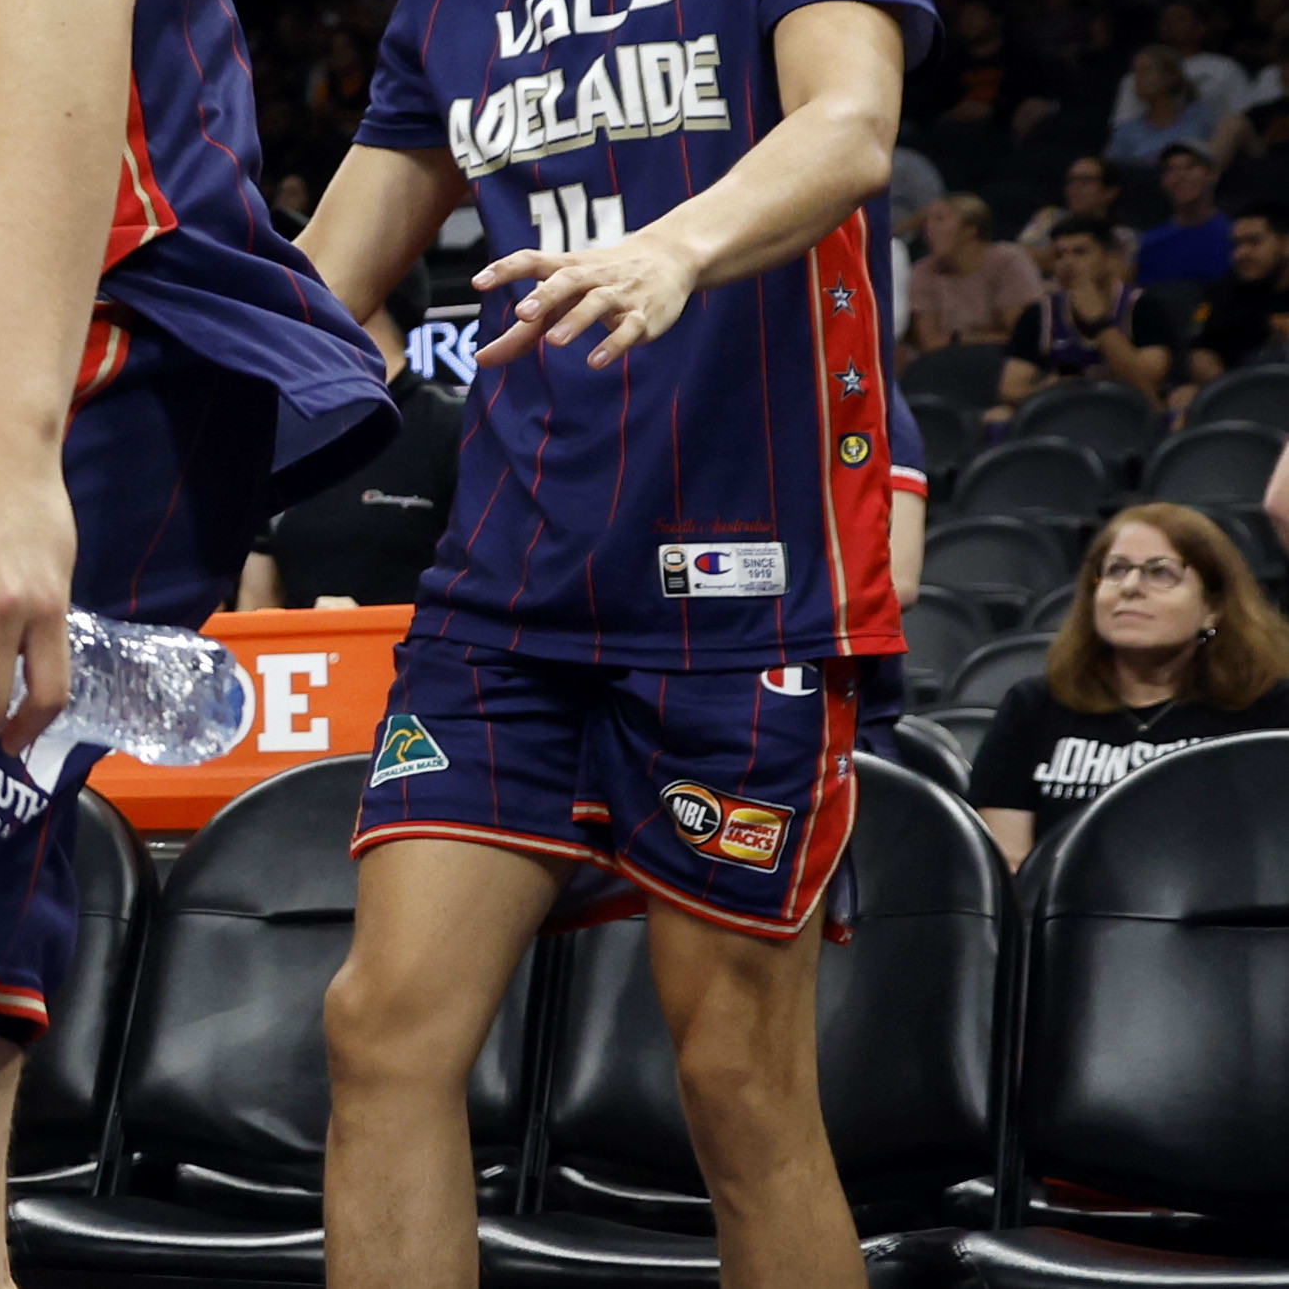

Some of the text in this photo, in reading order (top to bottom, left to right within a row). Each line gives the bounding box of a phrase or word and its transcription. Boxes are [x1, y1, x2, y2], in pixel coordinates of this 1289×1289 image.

[447, 34, 731, 180] ADELAIDE
[743, 557, 776, 569] SINCE
[748, 568, 773, 579] 1919
[673, 796, 708, 832] NBL
